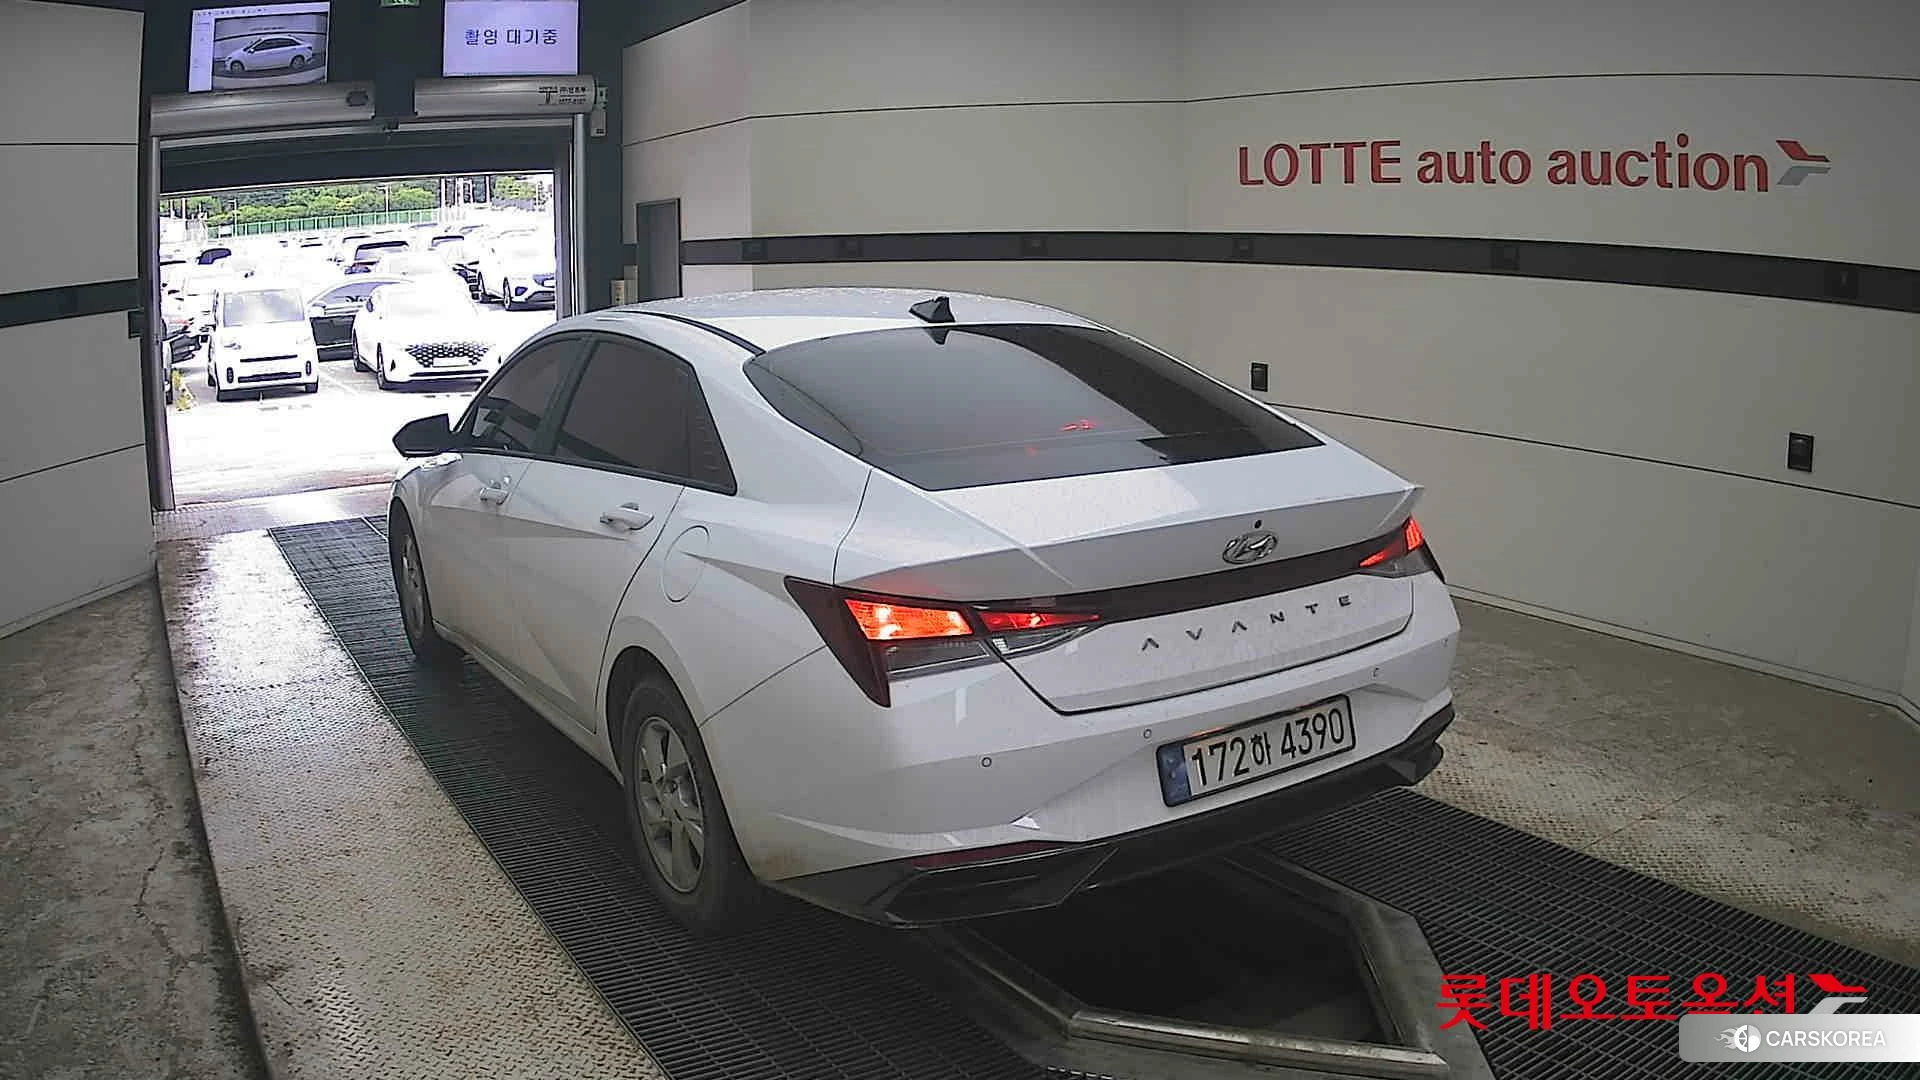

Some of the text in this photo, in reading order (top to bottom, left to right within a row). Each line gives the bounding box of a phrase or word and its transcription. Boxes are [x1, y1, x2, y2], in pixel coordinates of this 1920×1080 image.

[505, 28, 559, 46] 대기중
[1239, 133, 1770, 193] LOTTE auto auction
[1140, 594, 1353, 653] AVANTE
[1191, 707, 1346, 787] 172하 4390
